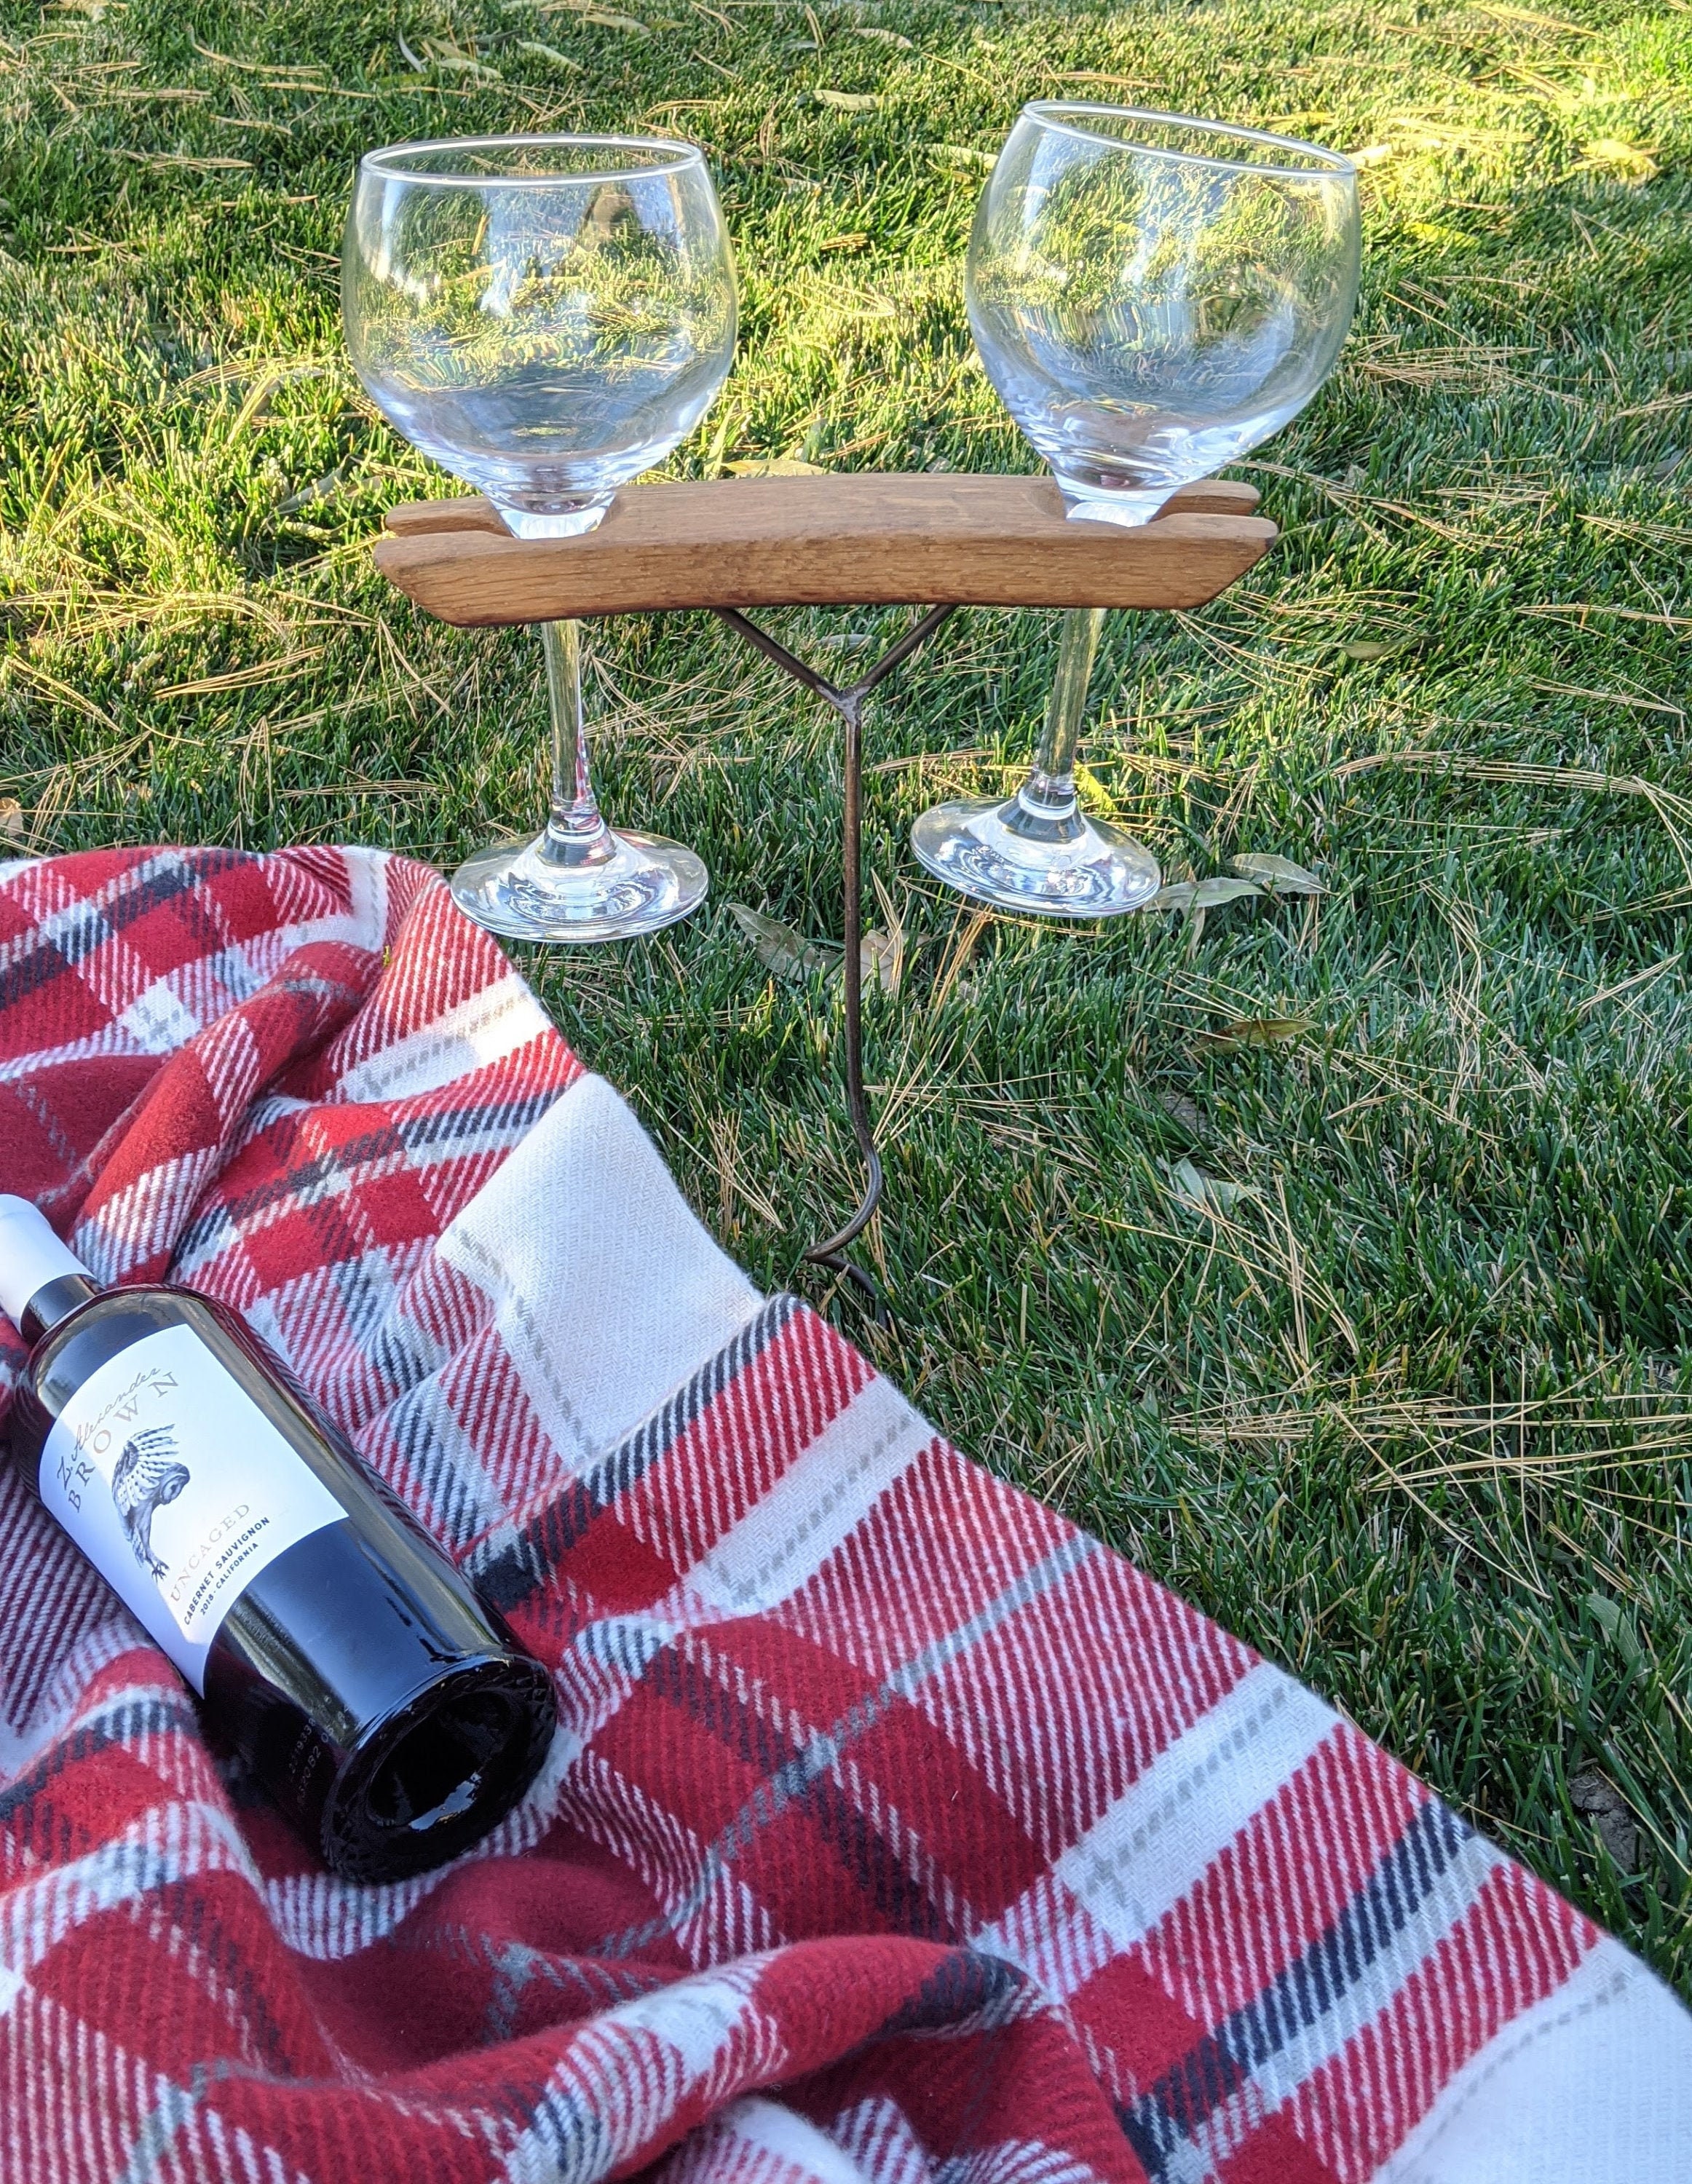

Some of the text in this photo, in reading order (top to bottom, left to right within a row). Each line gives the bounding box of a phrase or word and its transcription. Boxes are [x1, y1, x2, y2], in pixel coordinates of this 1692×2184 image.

[68, 1372, 179, 1514] BROWN
[71, 1368, 161, 1462] Alexander
[170, 1504, 250, 1602] UNCAGED
[184, 1516, 270, 1625] CABERNET SAUVIGNON
[200, 1543, 259, 1616] 2018 CALIFORNIA
